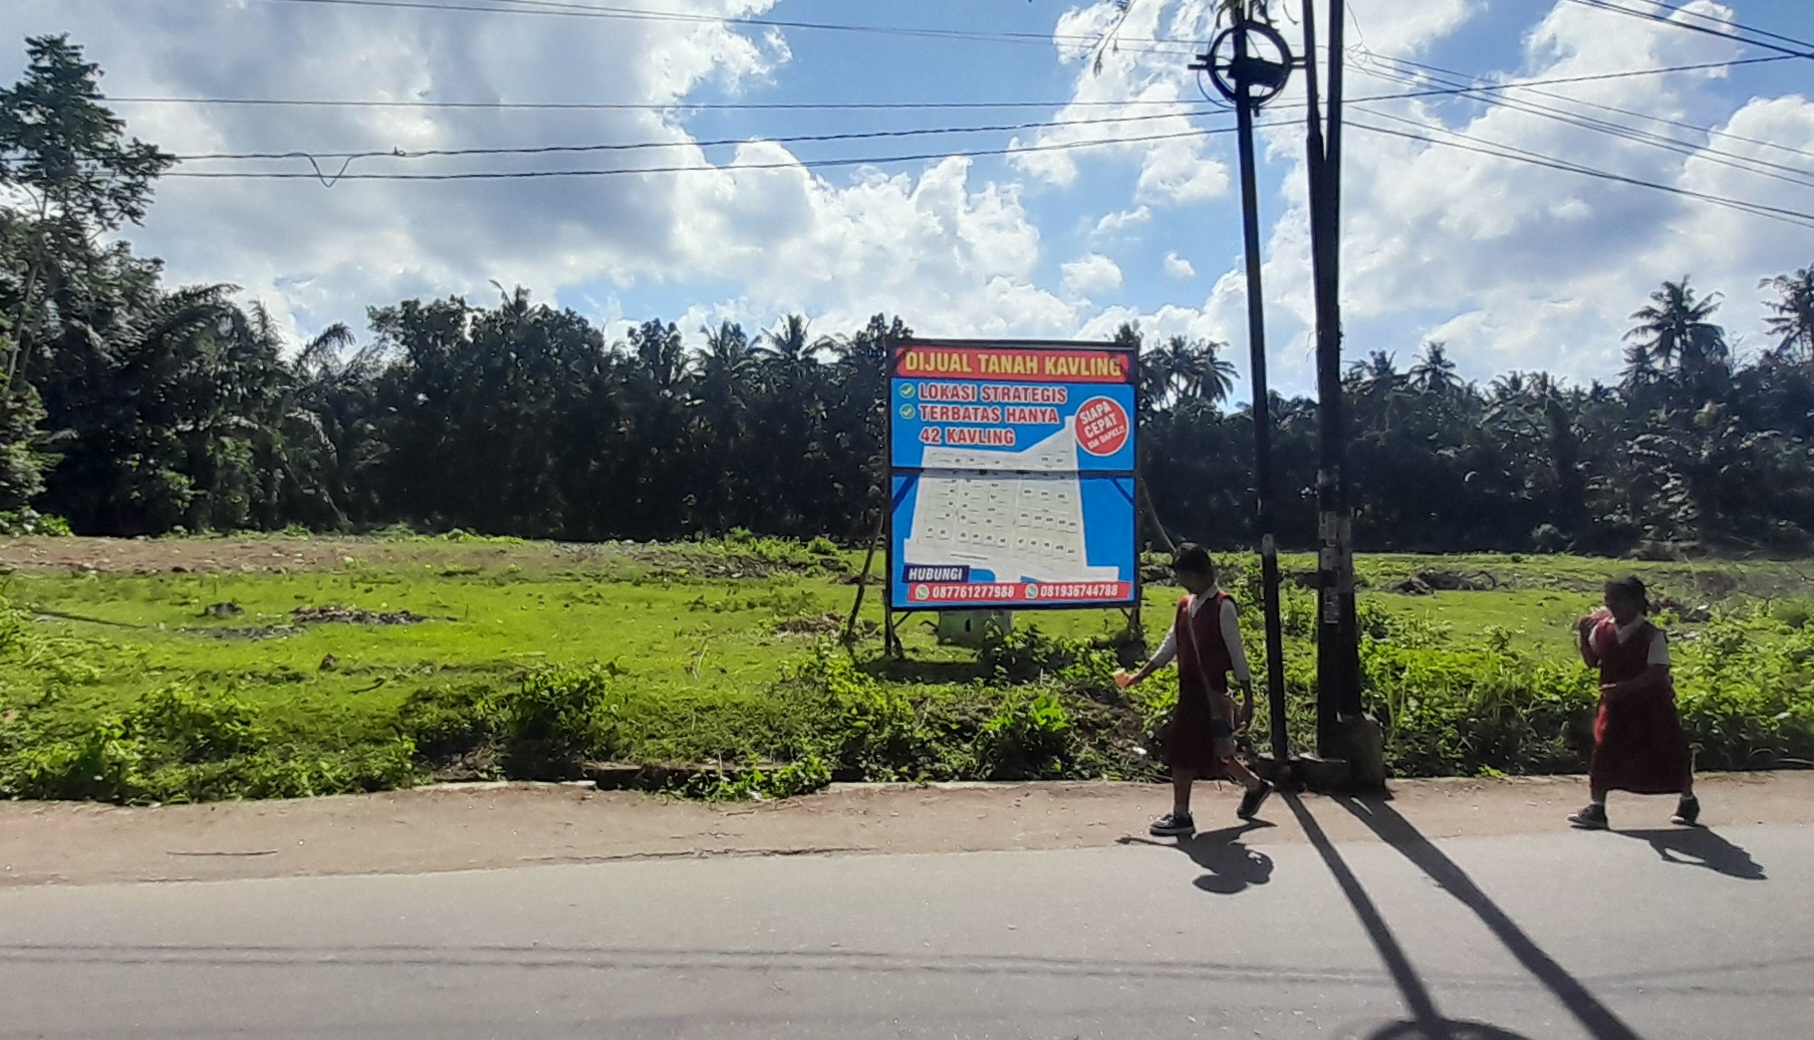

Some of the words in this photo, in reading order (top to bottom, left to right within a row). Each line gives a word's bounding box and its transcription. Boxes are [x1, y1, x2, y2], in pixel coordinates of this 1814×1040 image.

[905, 351, 973, 373] DIJUAL
[977, 353, 1038, 375] TANAH
[1045, 356, 1121, 376] KAVLING
[919, 383, 977, 402] LOKASI
[981, 385, 1067, 403] STRATEGIS
[919, 405, 1001, 423] TERBATAS
[1005, 406, 1060, 424] HANYA
[1079, 401, 1112, 425] SIAPA
[1084, 412, 1117, 439] CEPAT
[919, 426, 941, 445] 42
[945, 427, 1016, 446] KAVLING
[908, 567, 963, 581] HUBUNGI
